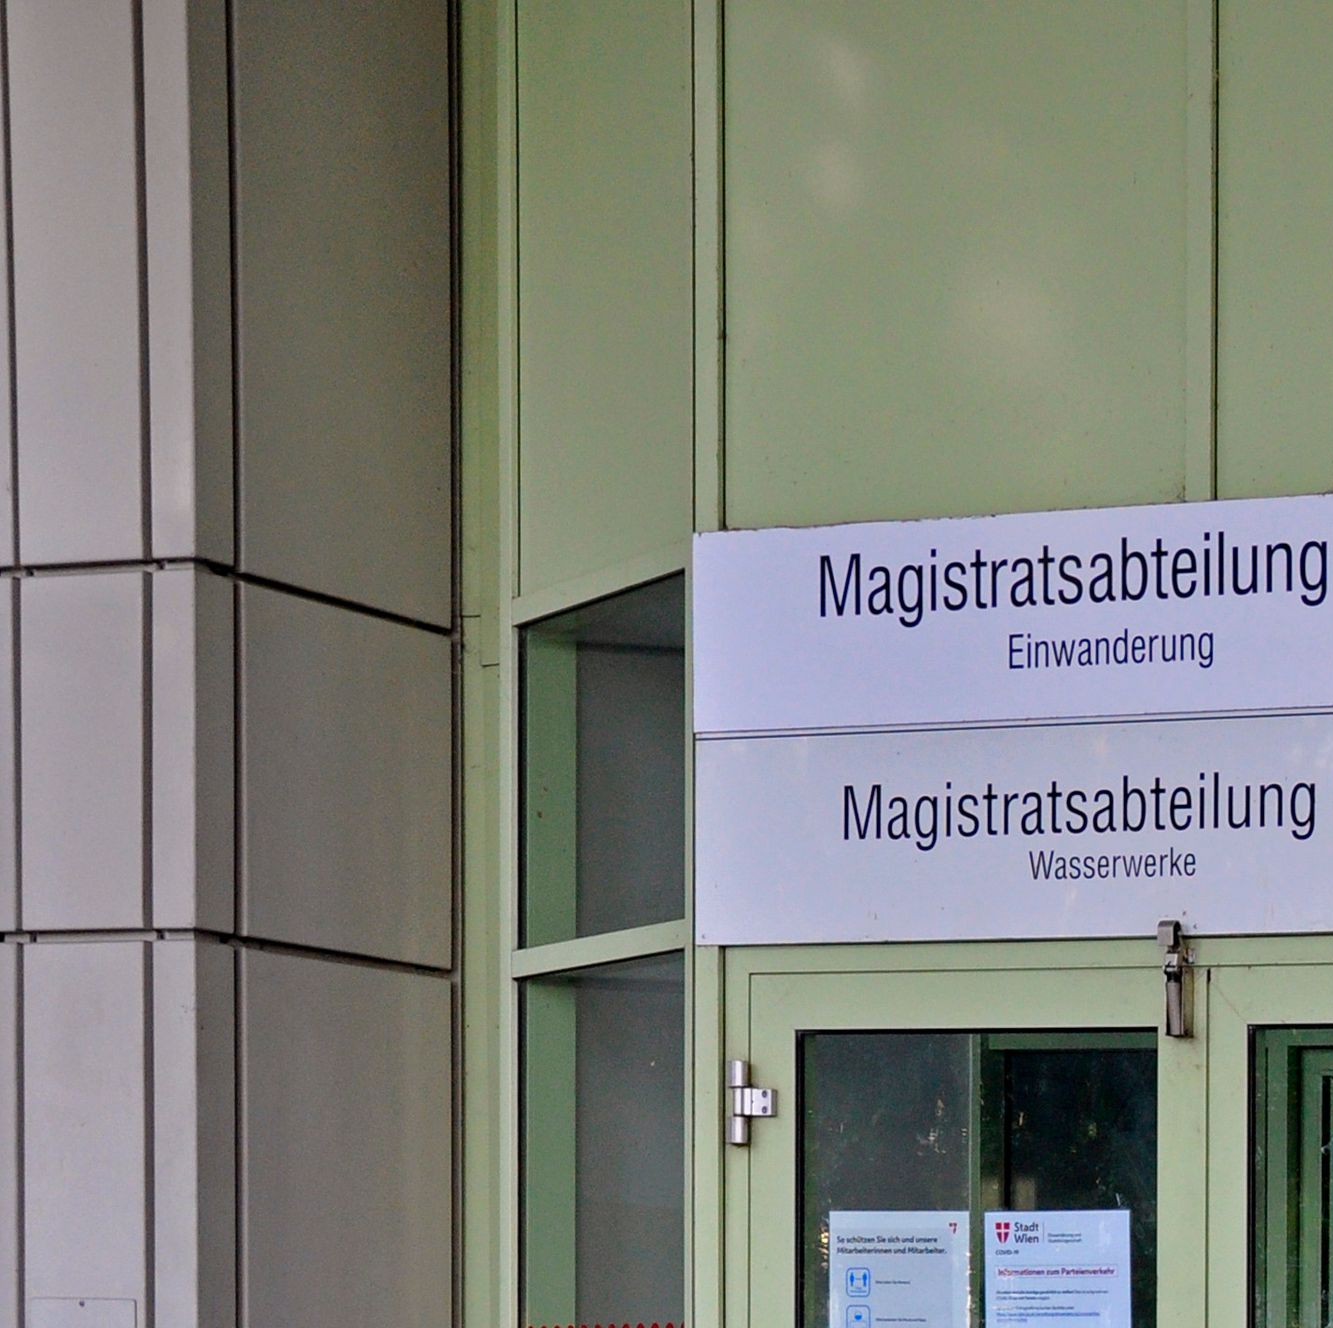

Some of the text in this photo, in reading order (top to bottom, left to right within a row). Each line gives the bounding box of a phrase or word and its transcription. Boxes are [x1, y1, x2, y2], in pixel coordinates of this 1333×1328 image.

[818, 532, 1329, 627] Magistratsabteilung
[1007, 625, 1215, 672] Einwanderung
[842, 775, 1317, 852] Magistratsabteilung
[1029, 848, 1197, 881] Wasserwerke
[1014, 1222, 1039, 1232] Stadt
[847, 1235, 874, 1244] schützen
[1015, 1233, 1039, 1244] Wien
[893, 1247, 906, 1255] und
[998, 1267, 1045, 1276] Informationen
[1061, 1267, 1114, 1276] Parteienverkehr
